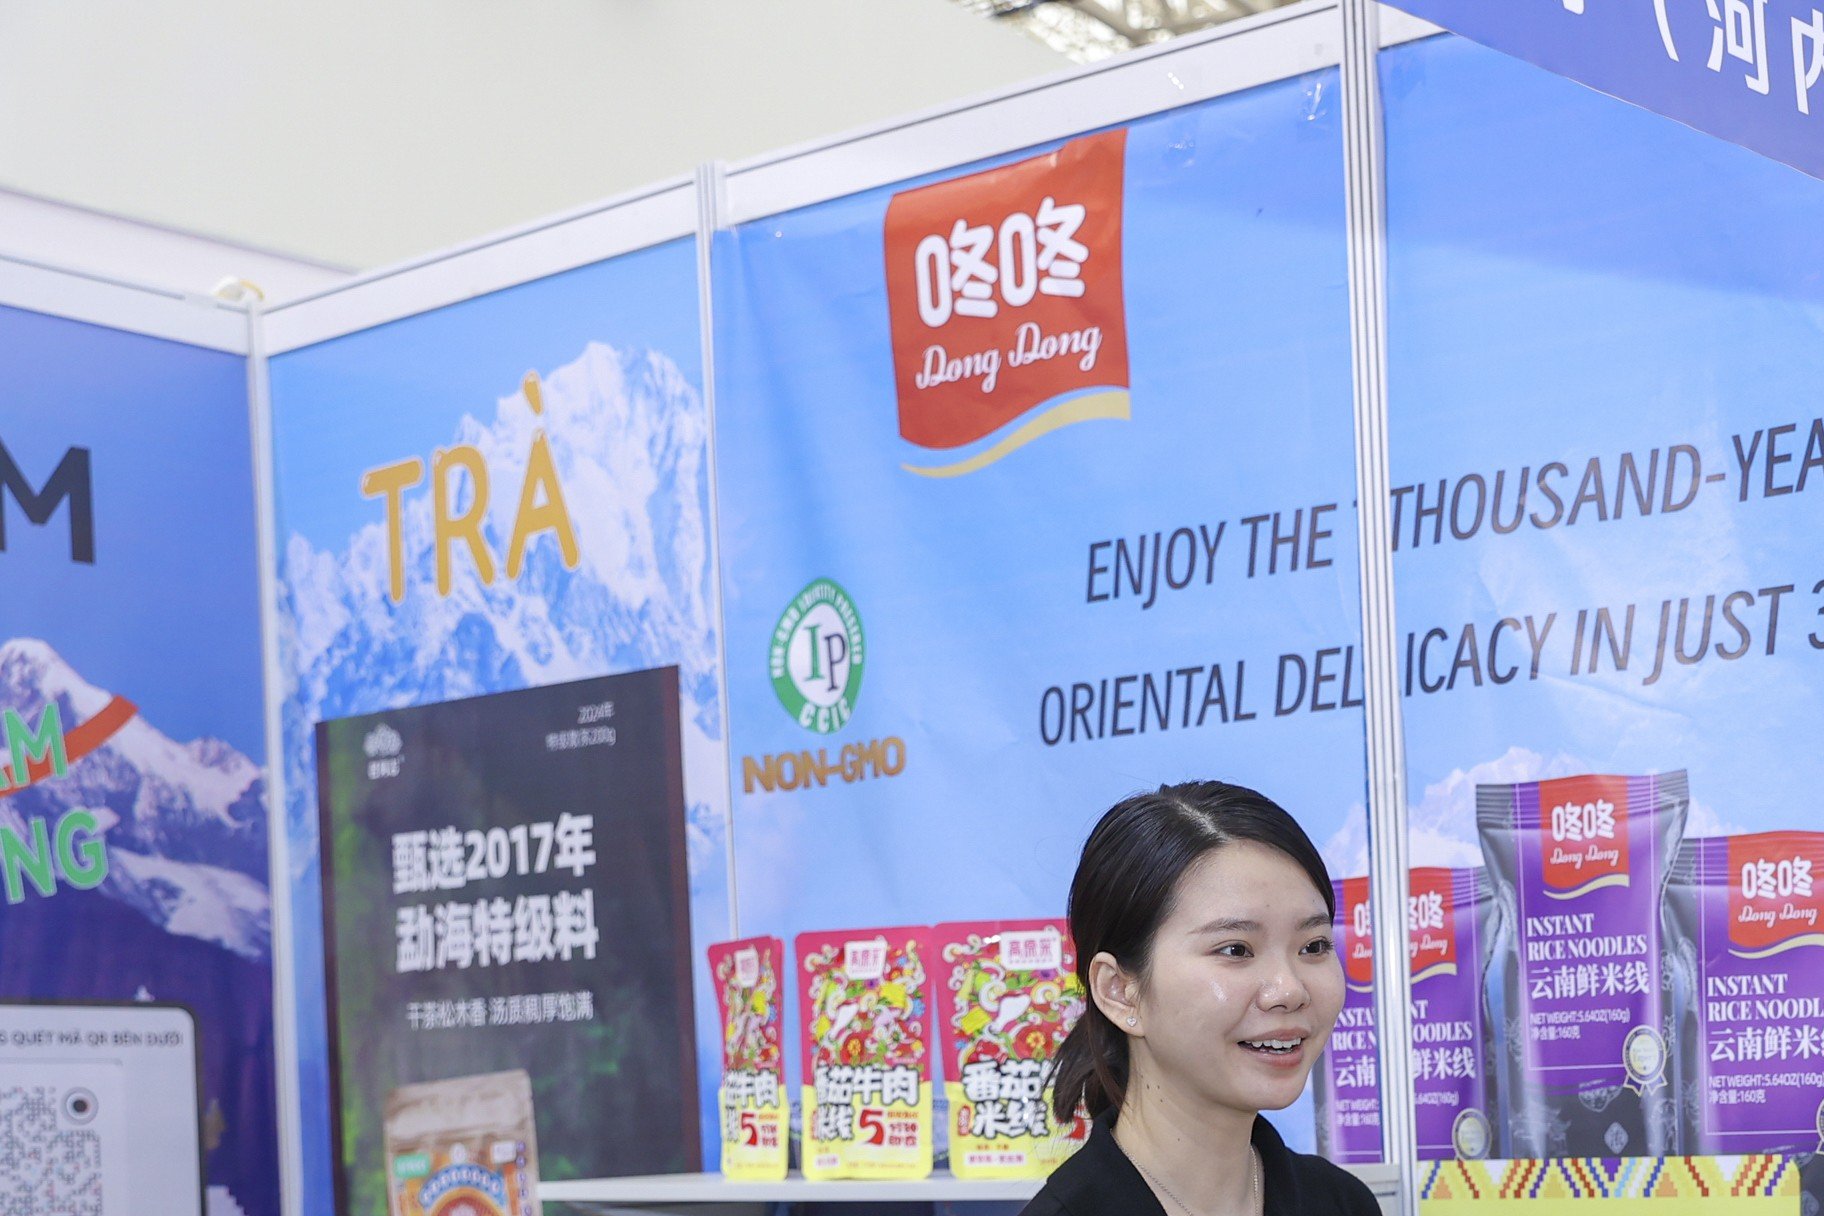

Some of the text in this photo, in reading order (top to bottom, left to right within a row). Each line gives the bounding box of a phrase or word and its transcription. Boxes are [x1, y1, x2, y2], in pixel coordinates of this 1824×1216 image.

[915, 197, 1089, 328] 咚咚
[915, 321, 1101, 393] Dong Dong
[362, 371, 579, 602] TRÀ
[1086, 521, 1227, 611] ENJOY
[1240, 503, 1338, 578] THE
[1039, 660, 1257, 747] ORIENTAL
[1275, 612, 1556, 717] DELICACY
[1570, 604, 1636, 677] IN
[1642, 584, 1794, 687] JUST
[799, 696, 850, 734] CCIC
[741, 735, 907, 795] NON-GMO
[1552, 798, 1616, 842] 咚咚
[391, 812, 597, 895] 甄选2017年
[1741, 856, 1814, 900] 咚咚
[394, 889, 600, 974] 勐海特级料
[1526, 912, 1595, 938] INSTANT
[1527, 933, 1648, 962] RICE NOODLES
[1528, 960, 1651, 1001] 云南鲜米线
[1707, 973, 1788, 998] INSTANT
[1707, 999, 1754, 1023] RICE
[1332, 1030, 1367, 1051] RICE
[859, 1109, 886, 1146] 5
[972, 1102, 1050, 1139] 米线
